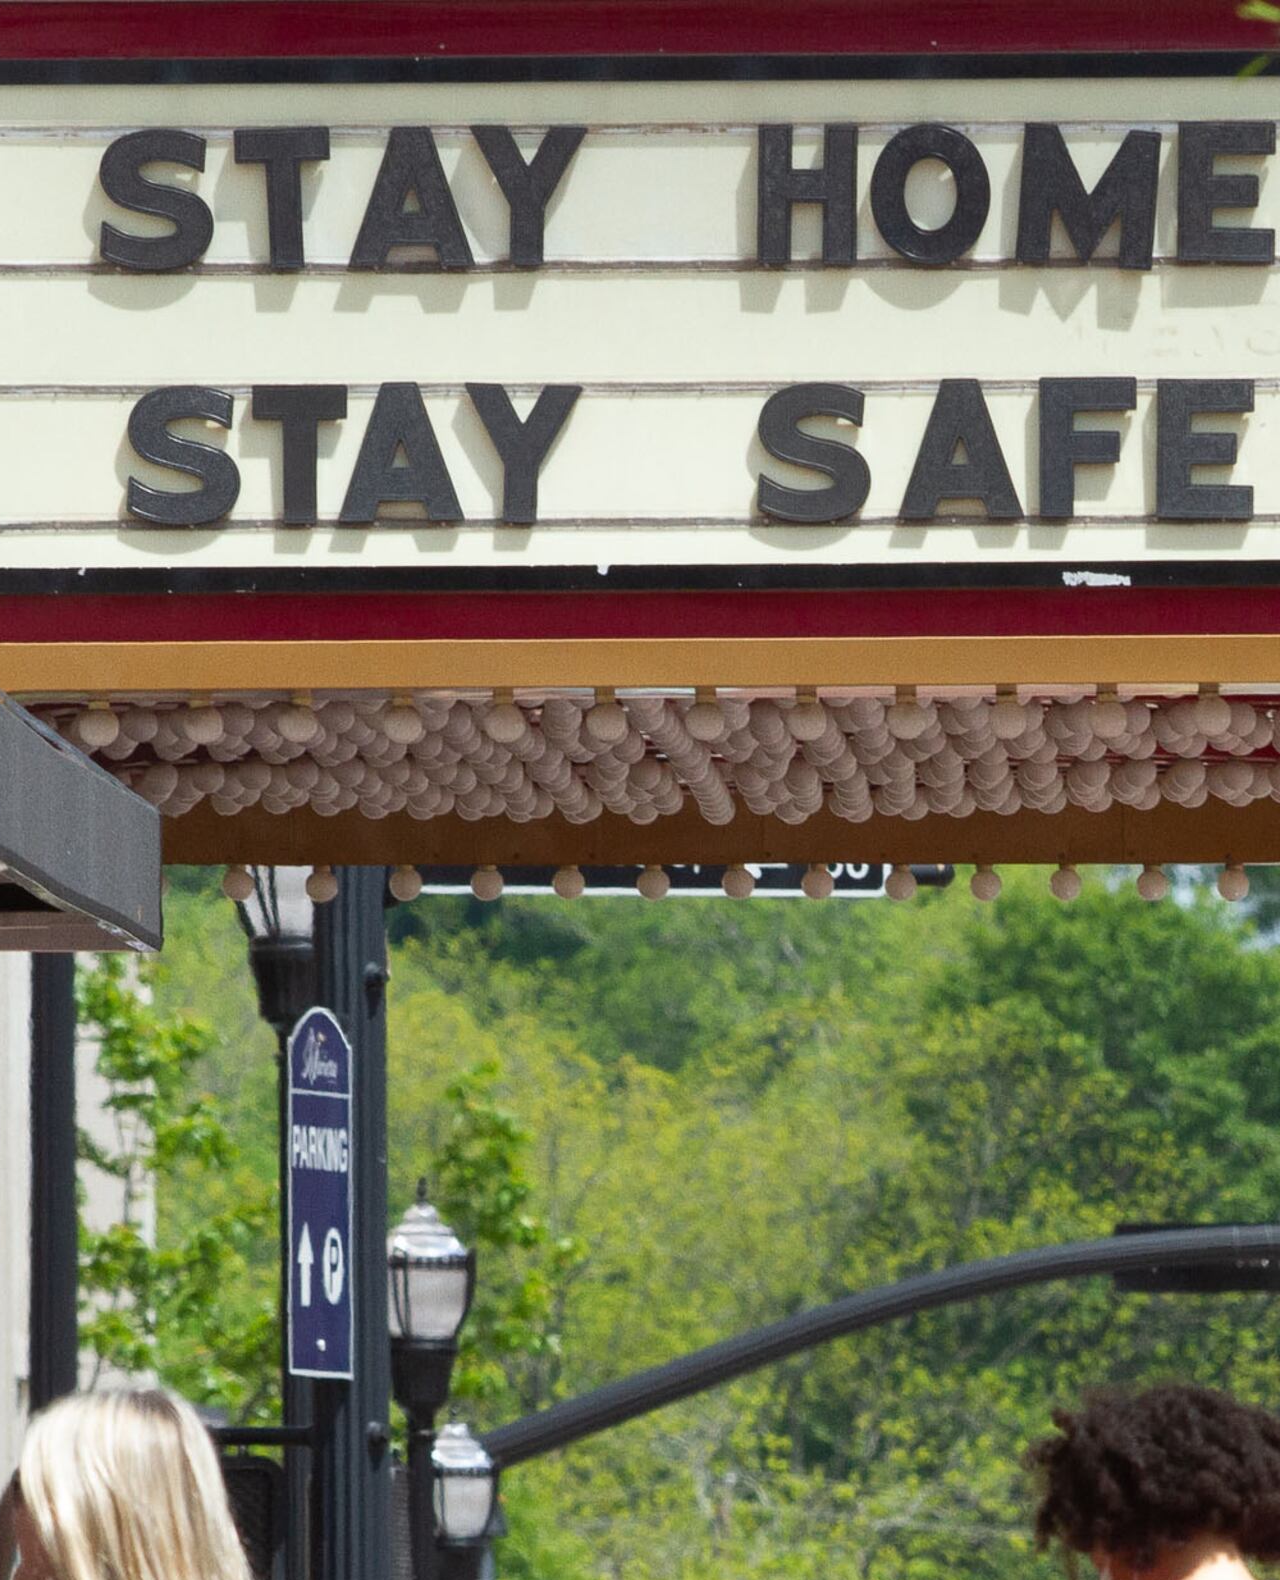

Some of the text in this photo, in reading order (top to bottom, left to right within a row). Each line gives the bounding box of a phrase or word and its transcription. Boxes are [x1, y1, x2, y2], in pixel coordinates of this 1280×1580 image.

[100, 121, 1277, 273] STAY HOME
[126, 377, 1255, 531] STAY SAFE
[292, 1124, 348, 1174] PARKING
